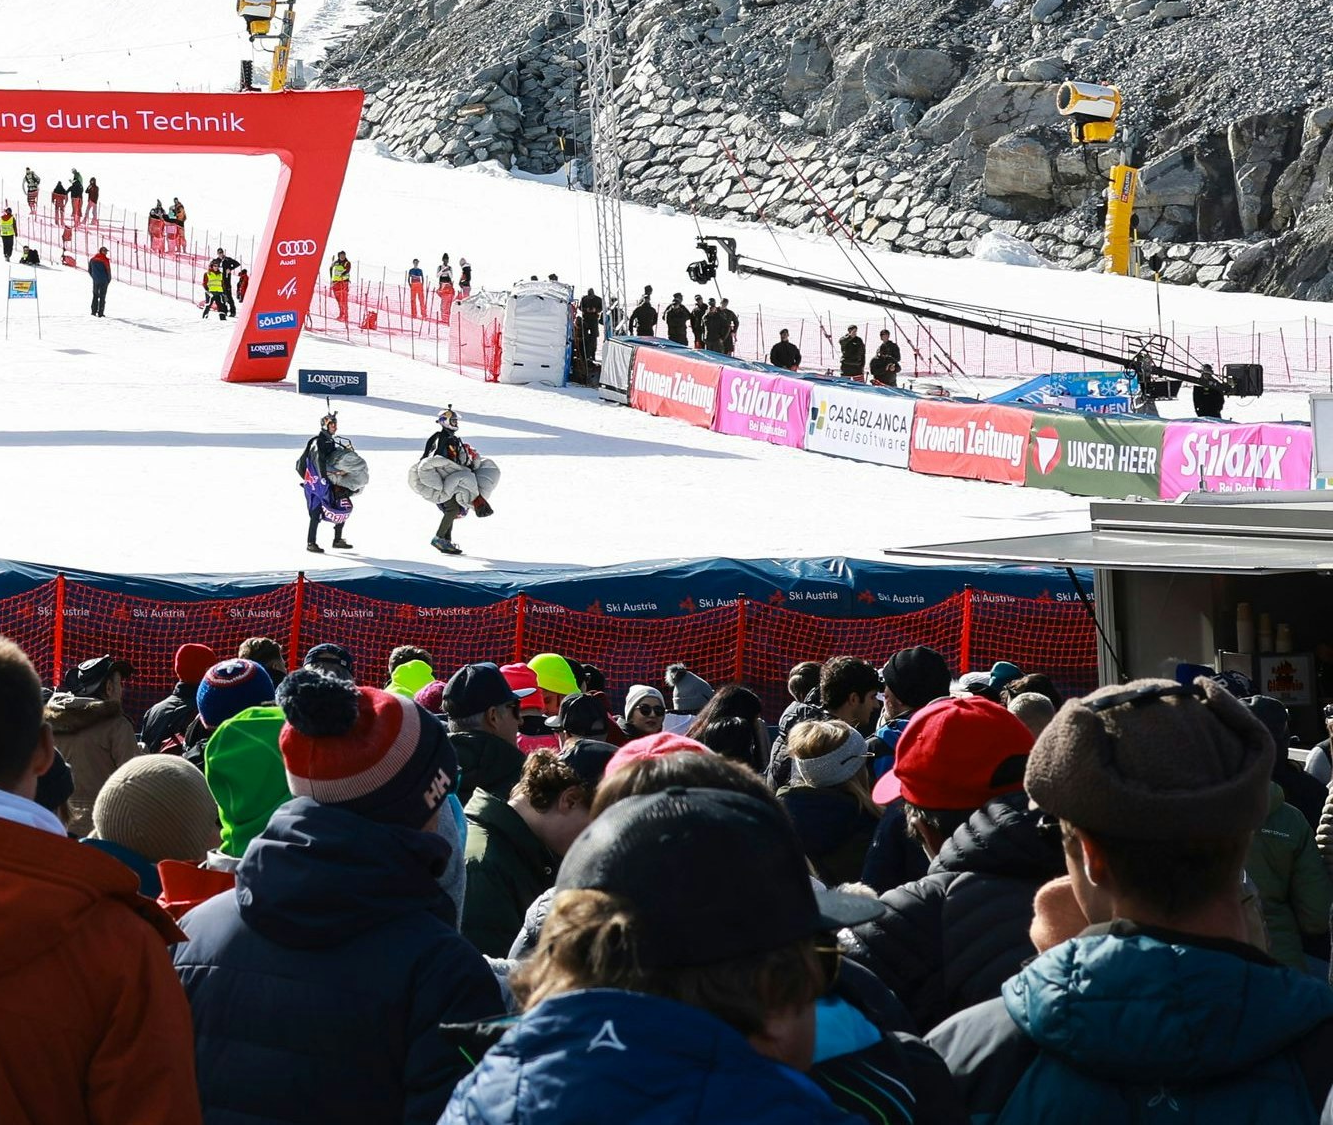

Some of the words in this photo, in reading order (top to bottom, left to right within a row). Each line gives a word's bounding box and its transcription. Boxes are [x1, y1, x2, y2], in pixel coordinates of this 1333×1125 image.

[46, 109, 129, 131] durch
[136, 110, 246, 133] Technik
[259, 313, 294, 328] SÖLDEN
[250, 344, 285, 352] LONGINES
[307, 374, 360, 385] LONGINES
[636, 362, 673, 399] Kronen
[671, 373, 715, 414] Zeitung
[1078, 401, 1126, 413] ÖLDEN
[828, 404, 908, 434] CASABLANCA
[749, 420, 759, 432] Bei
[825, 425, 906, 452] hotelsoftware
[914, 418, 965, 455] Kronen
[965, 421, 1025, 467] Zeitung
[1067, 440, 1114, 472] UNSER
[1118, 445, 1158, 475] HEER
[789, 590, 804, 601] Ski
[806, 590, 839, 601] Austria
[877, 592, 891, 602] Ski
[893, 593, 925, 604] Austria
[982, 593, 1016, 604] Austria
[606, 602, 622, 613] Ski
[624, 601, 658, 613] Austria
[717, 597, 751, 608] Austa
[62, 608, 90, 617] ustria
[133, 608, 148, 618] Ski
[150, 608, 185, 618] Austria
[229, 608, 246, 618] Ski
[248, 608, 281, 618] Austria
[323, 608, 339, 618] Ski
[340, 608, 374, 618] Austria
[418, 606, 434, 617] Ski
[436, 606, 470, 617] Austria
[513, 605, 529, 615] Si
[532, 603, 565, 614] Austria
[423, 767, 451, 809] HH
